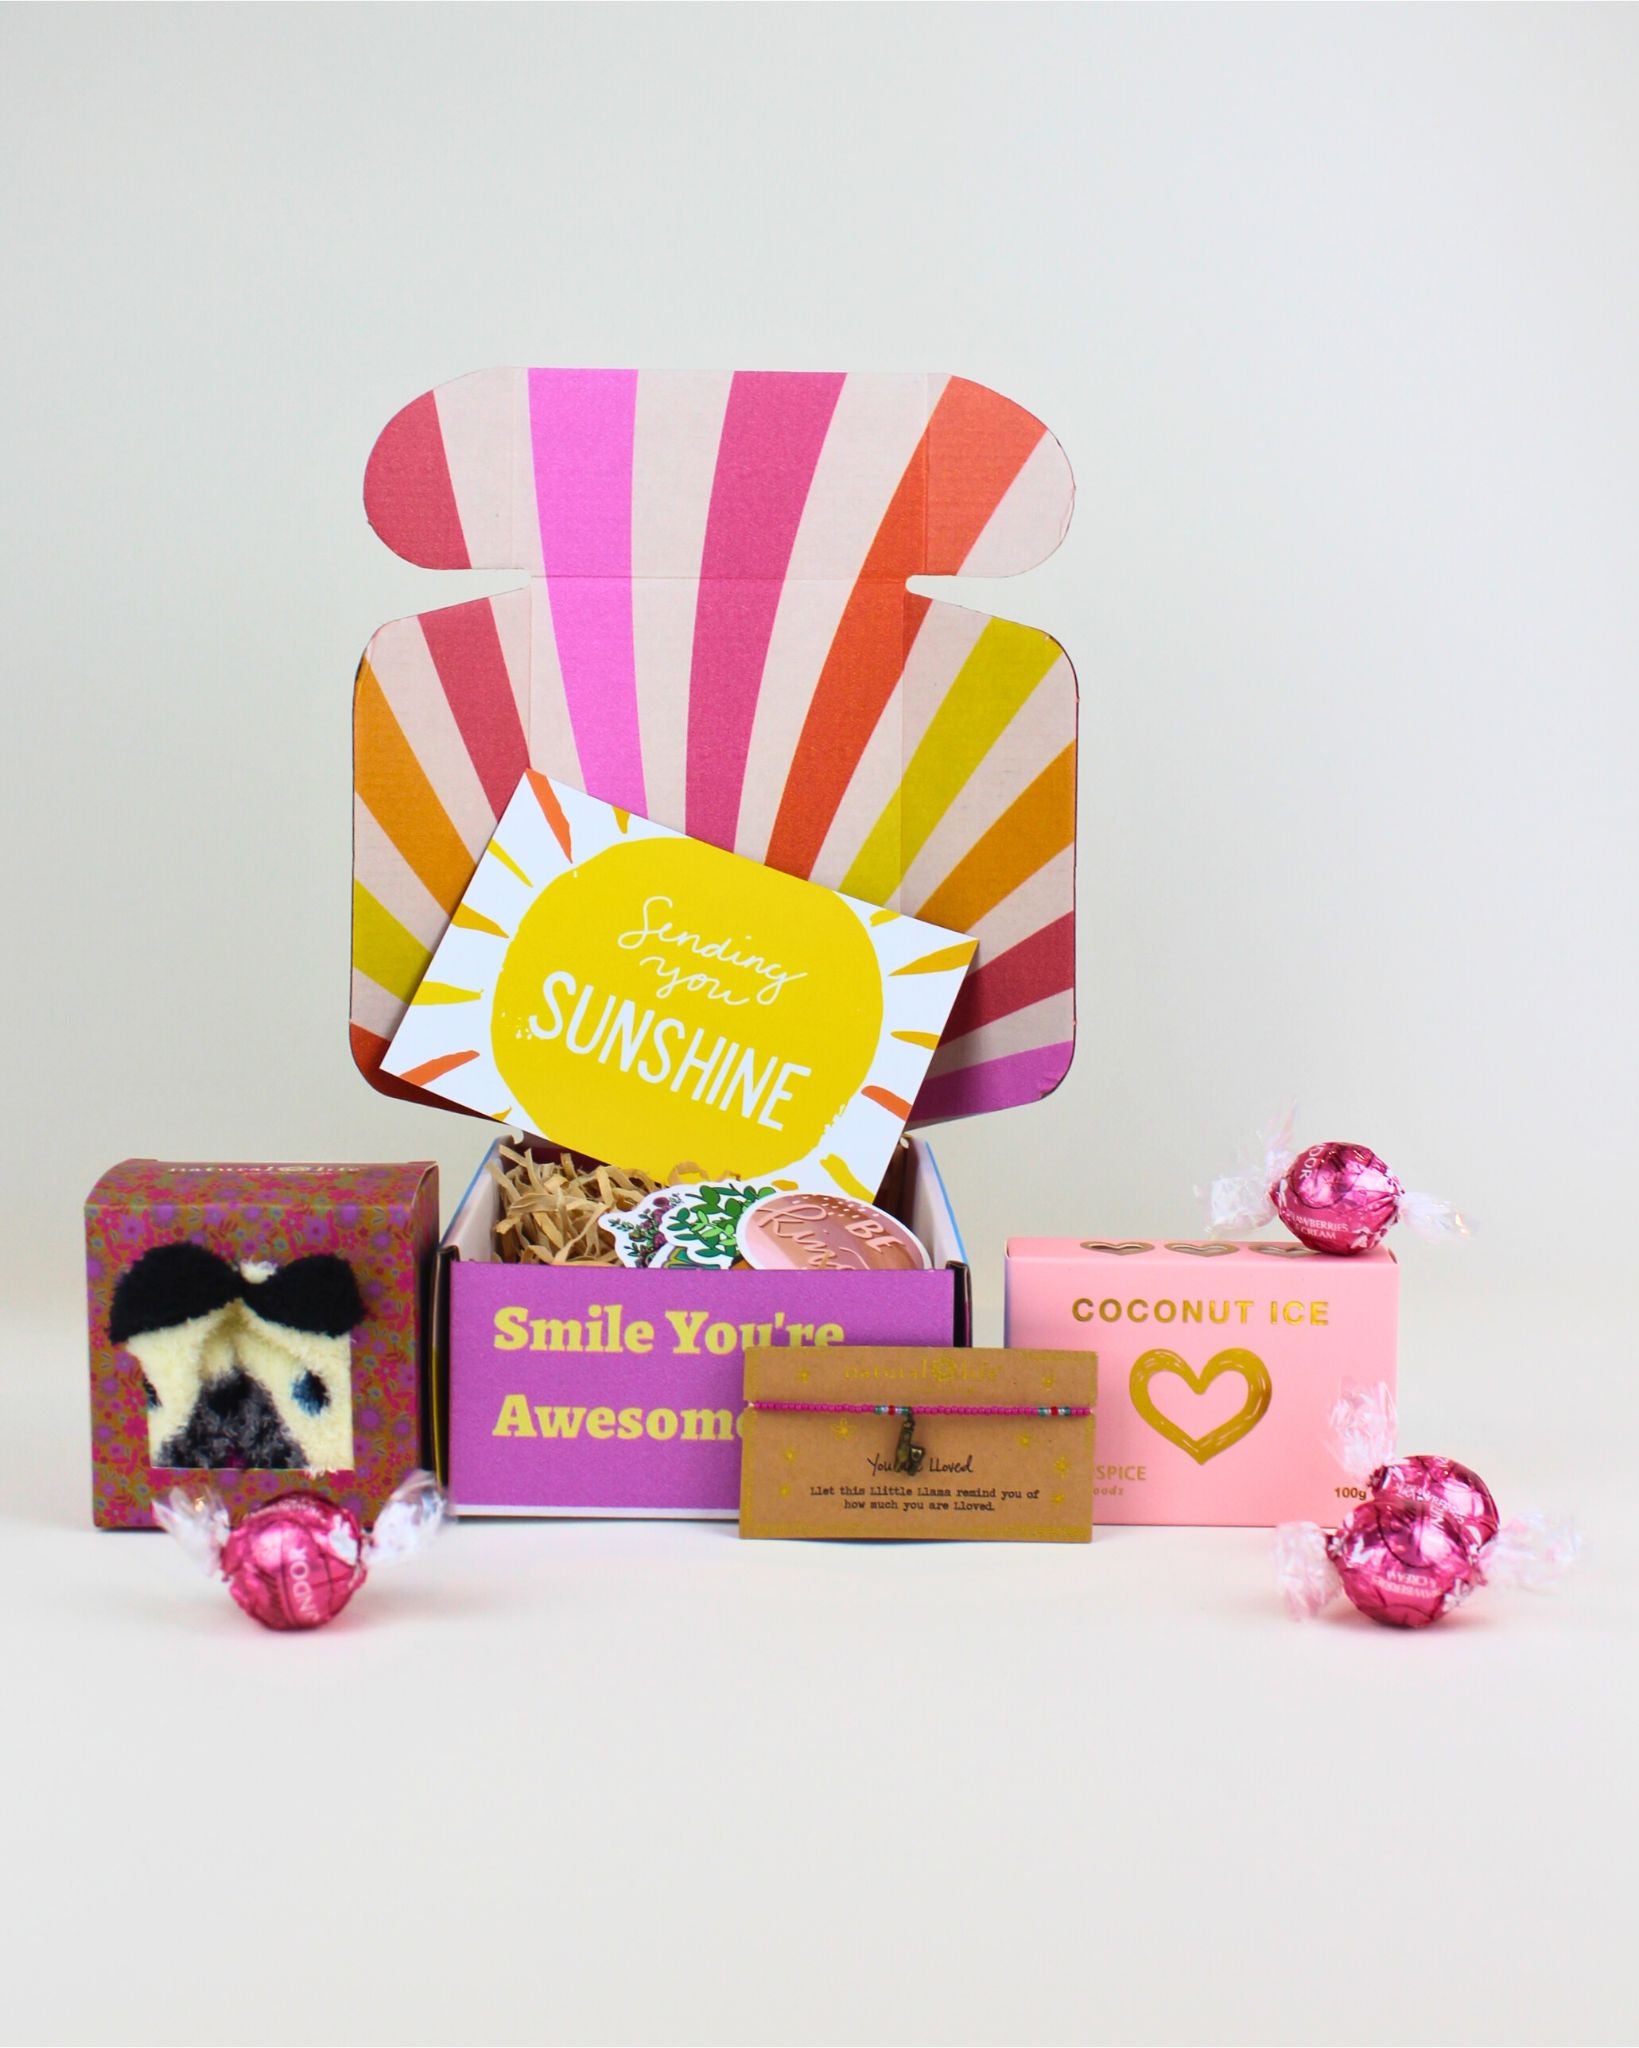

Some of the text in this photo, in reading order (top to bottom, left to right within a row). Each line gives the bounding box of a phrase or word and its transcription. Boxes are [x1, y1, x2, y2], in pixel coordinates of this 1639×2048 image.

[617, 896, 809, 1005] Sending
[639, 956, 750, 1006] you
[528, 970, 813, 1132] SUNSHINE
[845, 1219, 906, 1255] BE
[1071, 1297, 1330, 1326] COCONUT ICE
[493, 1304, 845, 1355] Smile You're
[866, 1453, 896, 1477] You
[1095, 1465, 1147, 1481] SPICE
[810, 1486, 1040, 1500] Llet this Llittle Llama remind you of
[844, 1499, 865, 1510] how
[870, 1499, 898, 1510] much
[903, 1501, 924, 1512] you
[929, 1501, 949, 1510] are
[1334, 1486, 1367, 1501] 100g
